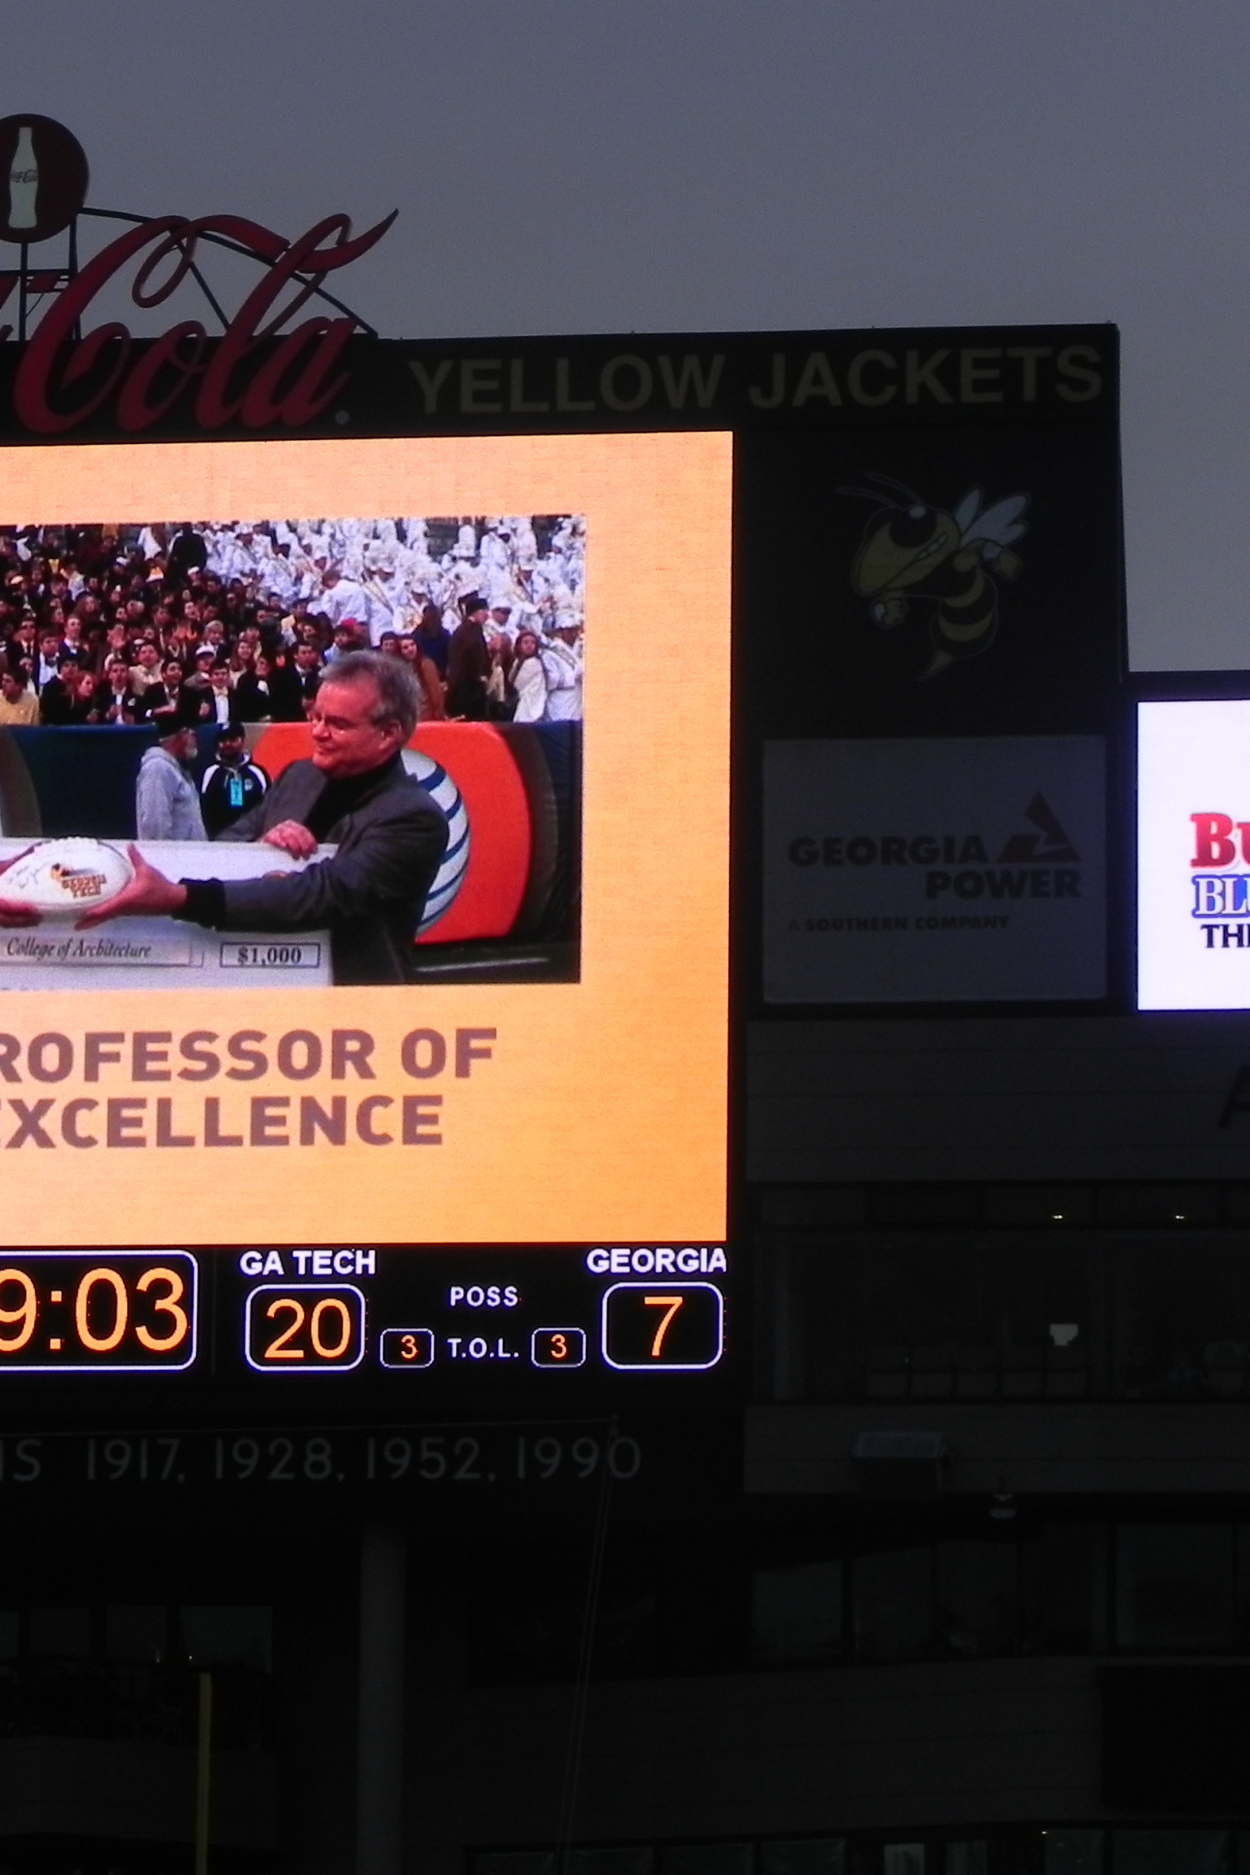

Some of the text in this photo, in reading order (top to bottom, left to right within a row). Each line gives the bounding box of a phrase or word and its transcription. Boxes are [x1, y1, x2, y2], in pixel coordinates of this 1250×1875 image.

[408, 344, 1104, 414] YELLOW JACKETS
[788, 834, 989, 866] GEORGIA
[1190, 812, 1250, 868] B
[925, 868, 1081, 900] POWER
[1192, 874, 1250, 919] BL
[804, 917, 908, 932] SOUTHERN
[915, 915, 1010, 930] COMPANY
[1200, 923, 1250, 948] TH
[7, 937, 152, 960] College of Architecture
[237, 946, 302, 966] $1,000
[401, 1028, 497, 1079] OF
[240, 1249, 376, 1276] GA TECH
[586, 1247, 727, 1274] GEORGIA
[450, 1286, 519, 1306] POSS
[264, 1298, 351, 1359] 20
[643, 1297, 684, 1357] 7
[401, 1335, 418, 1359] 3
[448, 1339, 519, 1358] T.O.L.
[550, 1335, 567, 1358] 3
[516, 1435, 642, 1480] 1990
